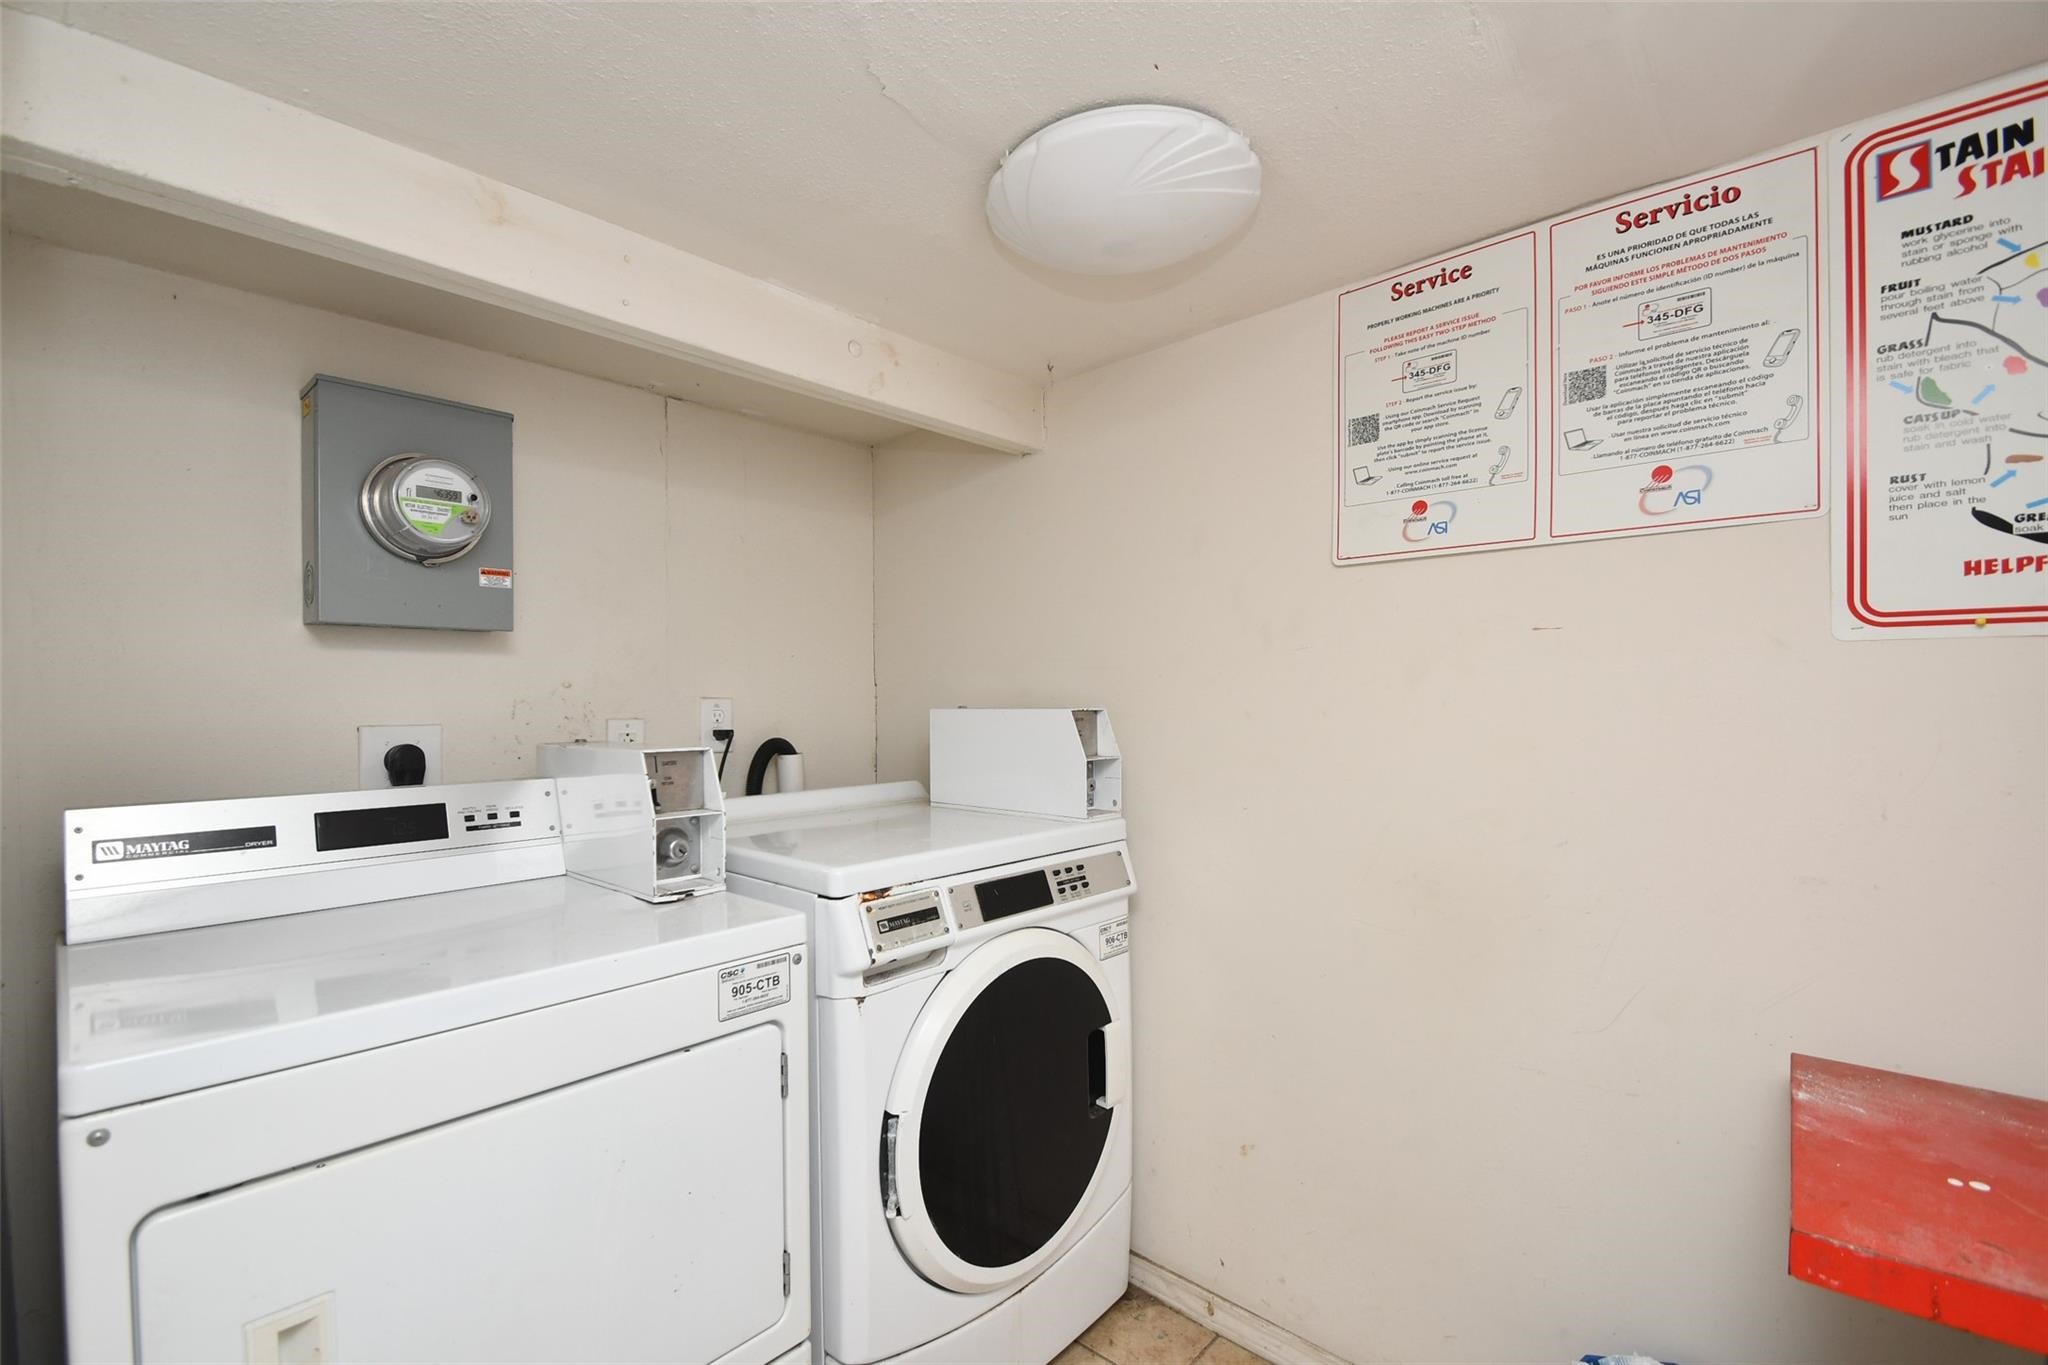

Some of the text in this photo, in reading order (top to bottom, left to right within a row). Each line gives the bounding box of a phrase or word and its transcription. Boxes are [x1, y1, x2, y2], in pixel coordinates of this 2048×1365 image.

[1954, 147, 2046, 200] STAI
[1615, 185, 1741, 234] Servicio
[1596, 211, 1759, 261] ES UNA PRIORIDAD DE QUE TODAS LAS
[1900, 214, 1973, 239] MUSTARD
[1901, 217, 2011, 248] work glycerine into
[1585, 216, 1773, 272] MÁQUINAS FUNCIONEN APROPRIADAMENTE
[1900, 240, 1988, 267] rubbing alcohol
[1901, 224, 2023, 258] stain or sponge with
[1574, 231, 1787, 292] POR FAVOR INFORME LOS PROBLEMAS DE MANTENIMIENTO
[1591, 246, 1767, 296] SIGUIENDO ESTE SIMPLE MÉTODO DE DOS PASOS
[1390, 264, 1472, 302] Service
[1564, 305, 1582, 314] PASO
[1591, 298, 1611, 307] Anote
[1619, 290, 1645, 300] número
[1655, 276, 1702, 291] identificación
[1702, 272, 1713, 280] (ID
[1714, 264, 1746, 277] number)
[1766, 251, 1800, 264] máquina
[1880, 278, 1921, 294] FRUIT
[1880, 276, 1983, 303] pour boiling water
[1366, 318, 1394, 330] PROPERLY
[1394, 309, 1422, 322] WORKING
[1422, 300, 1452, 314] MACHINES
[1453, 297, 1465, 305] ARE
[1471, 287, 1499, 300] PRIORITY
[1879, 295, 1985, 321] several feet above
[1880, 285, 1984, 311] through stain from
[1646, 303, 1704, 324] 345-DFG
[1369, 315, 1496, 354] FOLLOWING THIS EASY TWO-STEP METHOD
[1383, 333, 1404, 343] PLEASE
[1405, 326, 1429, 337] REPORT
[1435, 317, 1460, 329] SERVICE
[1461, 312, 1479, 322] ISSUE
[1589, 355, 1608, 364] PASO
[1618, 347, 1645, 357] Informe
[1654, 338, 1689, 350] problema
[1701, 322, 1760, 339] mantenimiento
[1876, 338, 1923, 355] GRASS
[1876, 340, 1977, 363] rub detergent into
[1408, 362, 1451, 380] 345-DFG
[1876, 345, 1999, 372] stain with bleach that
[1890, 370, 1914, 380] safe
[1918, 367, 1934, 375] for
[1939, 360, 1971, 371] fabric
[1902, 423, 2007, 442] rub detergent into
[1903, 424, 1930, 434] soak
[1948, 416, 1974, 427] cold
[1978, 413, 2012, 423] water
[1903, 435, 1992, 452] stain and wash
[1888, 476, 1986, 493] cover with lemon
[1889, 472, 1926, 485] RUST
[1888, 488, 1966, 503] juice and salt
[1888, 503, 1913, 511] then
[1917, 500, 1948, 510] place
[1967, 496, 1986, 504] the
[2014, 512, 2048, 523] GRE
[2014, 524, 2044, 532] soak
[1963, 554, 2048, 576] HELPF
[126, 840, 190, 856] MAYTAG
[245, 840, 274, 848] DRYER
[732, 975, 780, 998] 905-CTB
